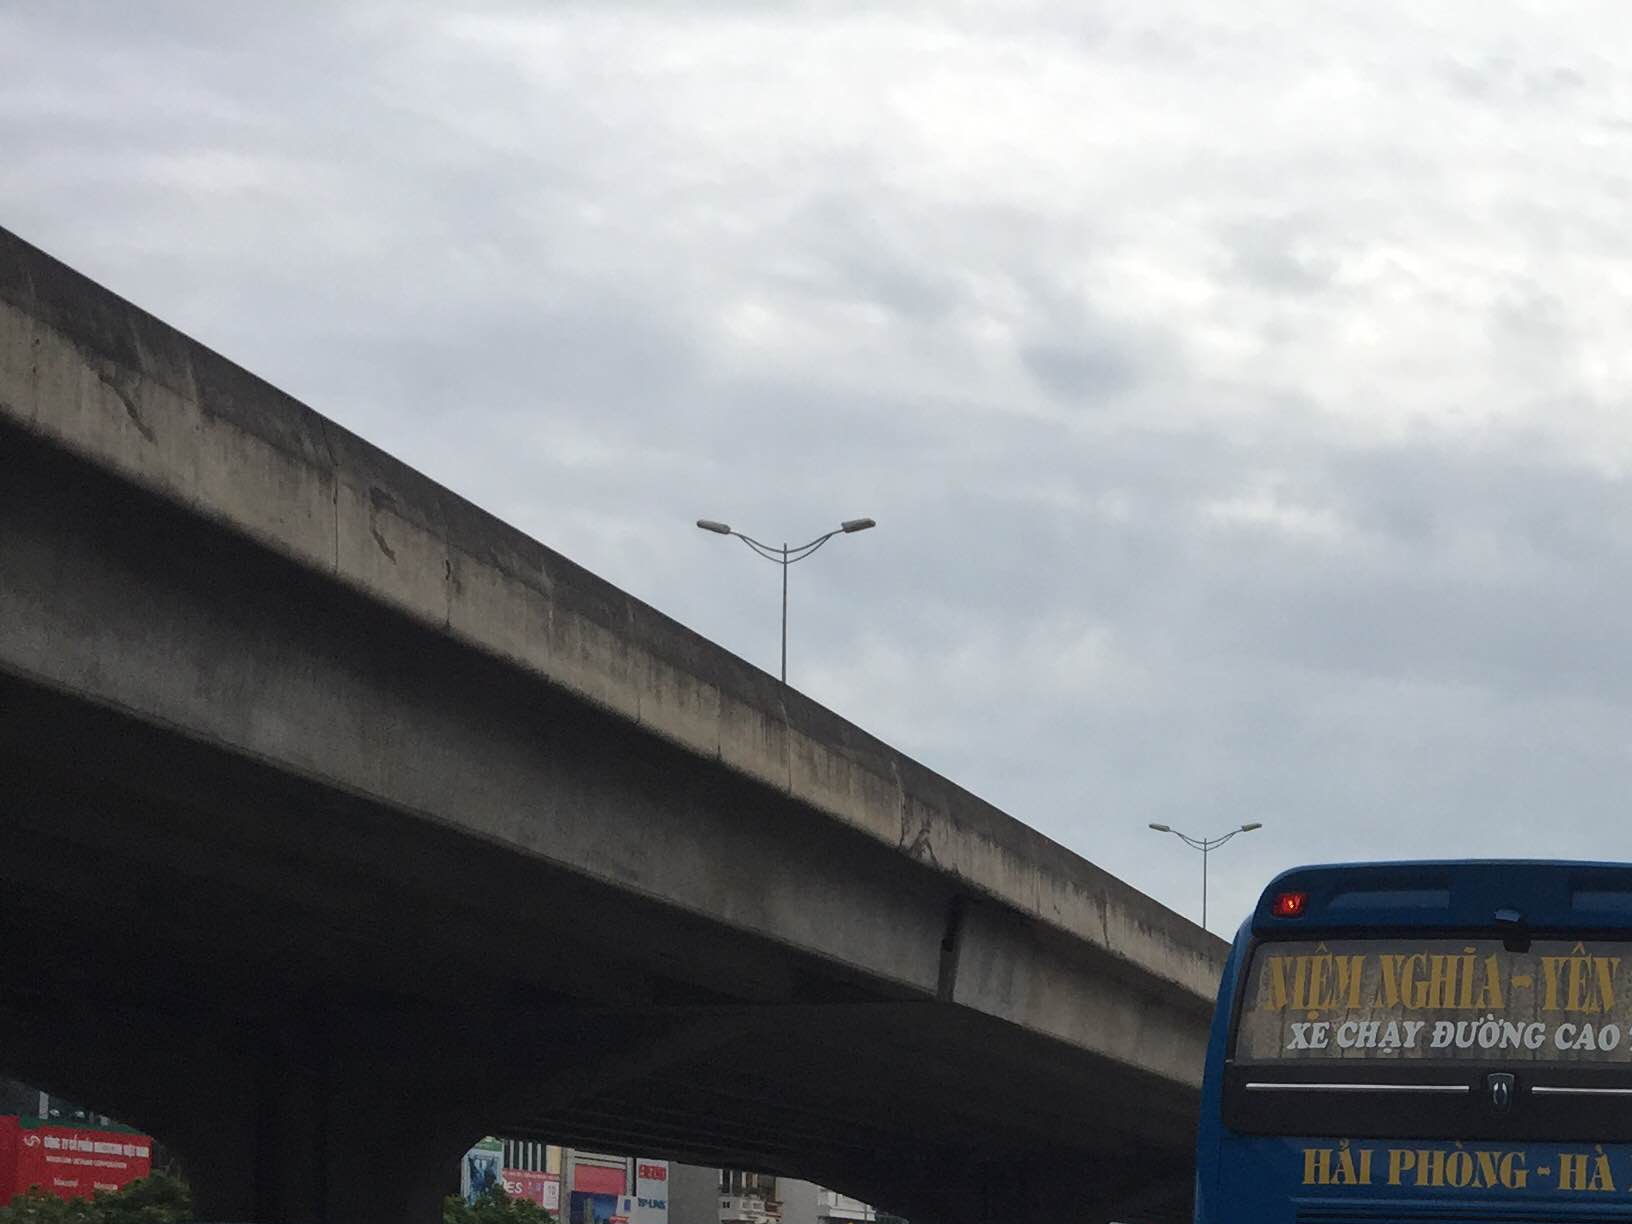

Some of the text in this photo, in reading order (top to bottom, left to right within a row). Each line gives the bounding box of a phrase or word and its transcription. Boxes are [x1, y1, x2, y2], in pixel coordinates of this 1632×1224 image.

[1264, 942, 1366, 1020] NIỆM
[1376, 946, 1505, 1009] NGHĨA
[1541, 942, 1621, 1014] YÊN
[1286, 1021, 1331, 1049] XE
[1336, 1021, 1425, 1054] CHẠY
[1430, 1013, 1546, 1049] ĐƯỜNG
[1554, 1023, 1621, 1051] CAO
[1302, 1138, 1373, 1186] HẢI
[1386, 1139, 1530, 1189] PHÒNG
[1556, 1143, 1616, 1191] HÀ
